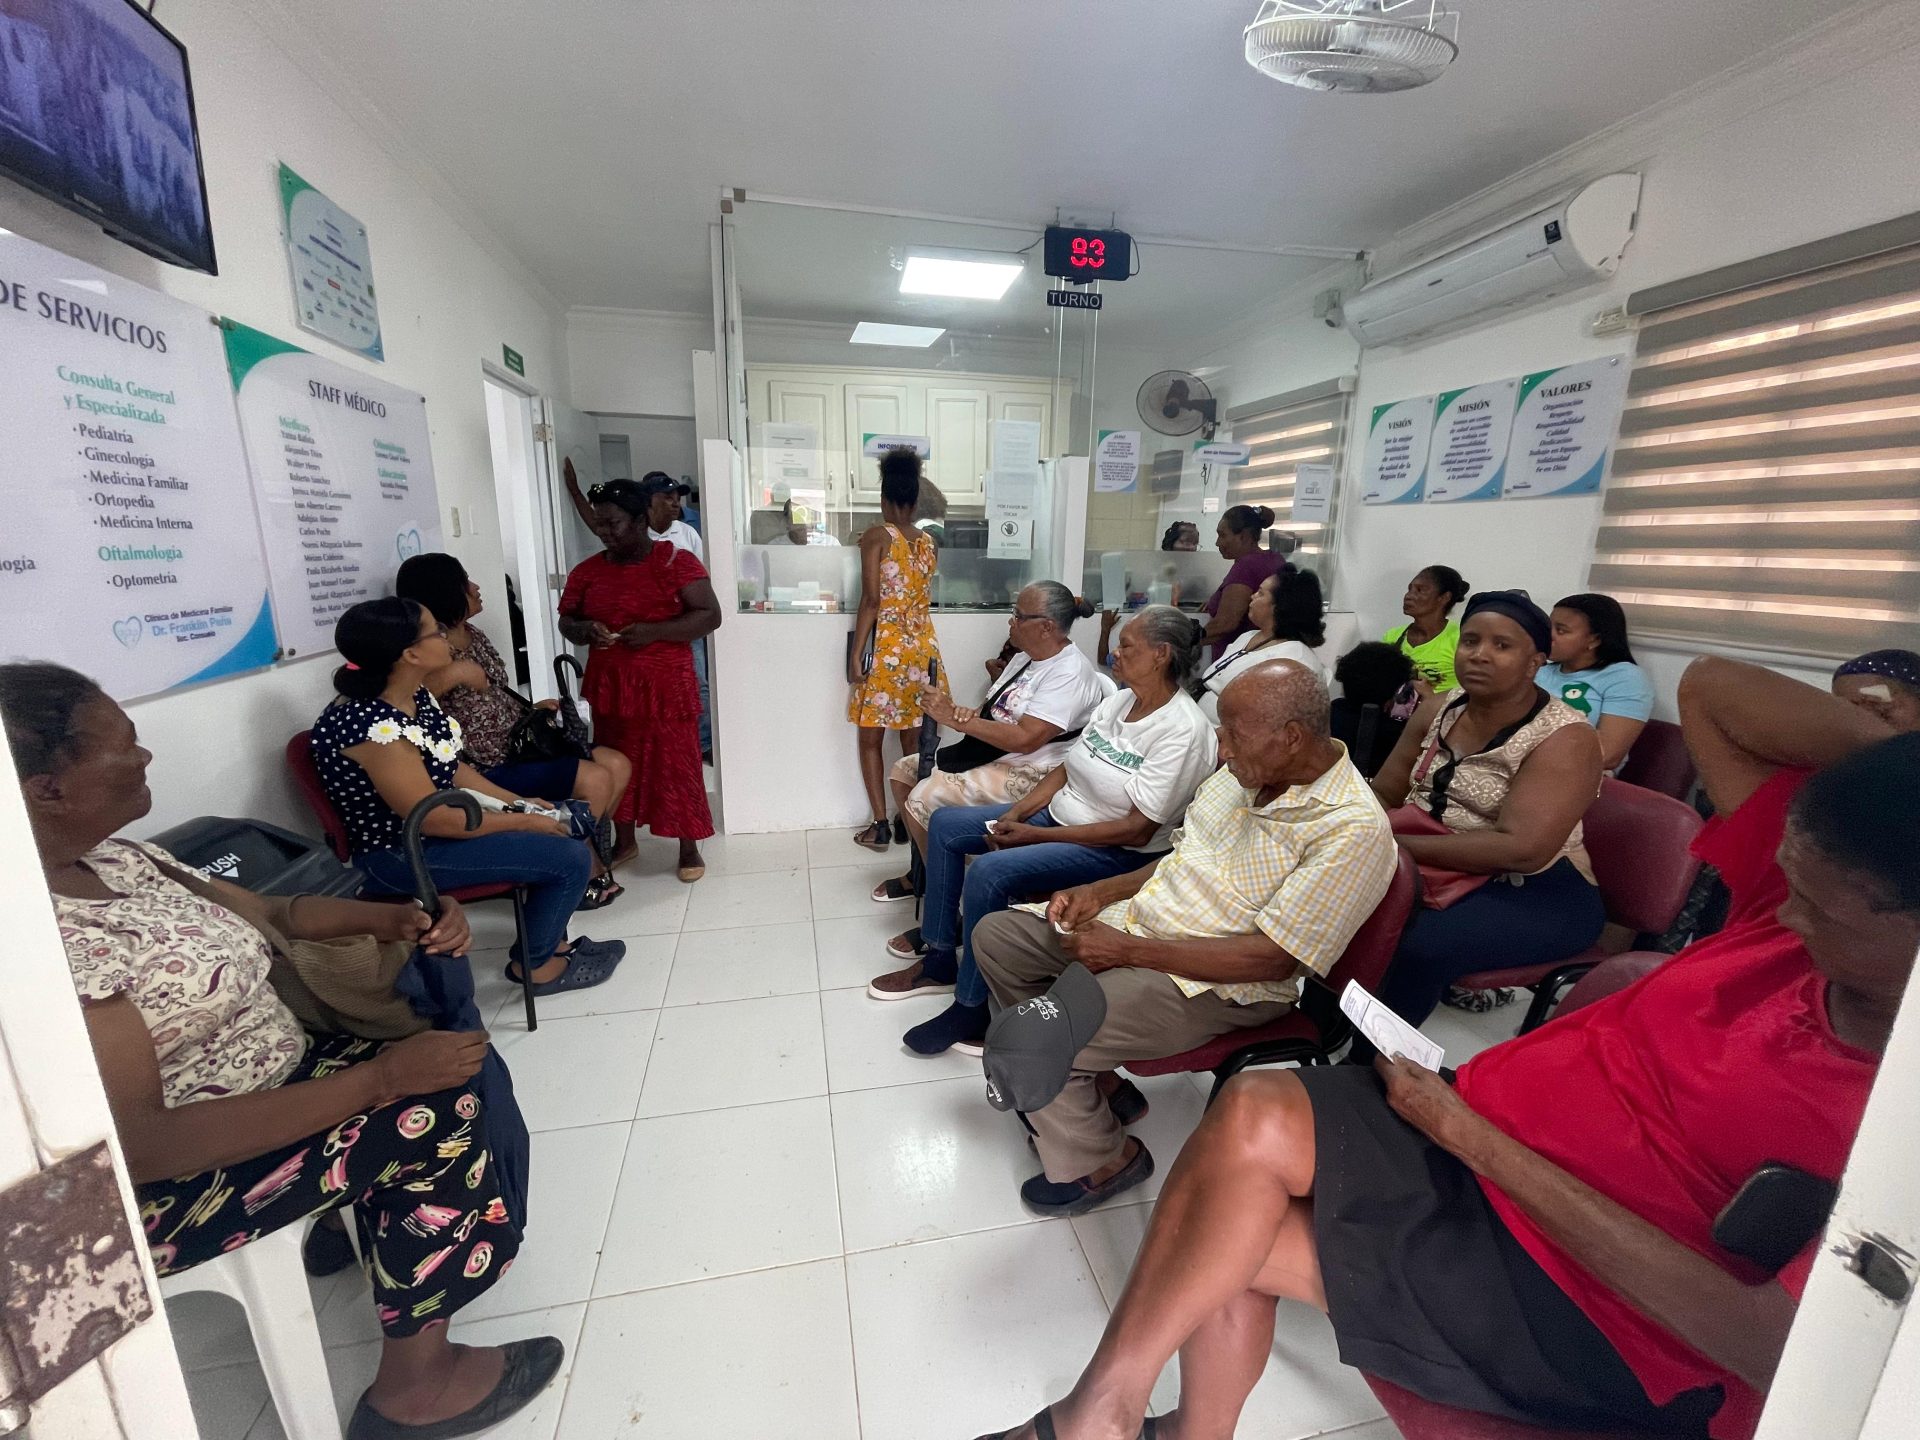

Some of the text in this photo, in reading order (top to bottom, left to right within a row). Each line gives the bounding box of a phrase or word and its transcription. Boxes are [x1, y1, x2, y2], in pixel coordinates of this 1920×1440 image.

[1071, 237, 1105, 268] 93
[1049, 291, 1100, 308] TURNO
[37, 291, 167, 353] SERVICIOS
[57, 365, 176, 405] Consulta General
[1540, 380, 1592, 398] VALORES
[309, 380, 386, 418] STAFF MÉDICO
[1458, 400, 1490, 414] MISIÓN
[63, 393, 166, 425] y Especializada
[1388, 418, 1413, 430] VISIÓN
[1535, 416, 1585, 430] Responsabilidad
[1546, 428, 1570, 437] Calidad
[1552, 464, 1567, 472] Dios
[90, 470, 189, 491] Medicina Familiar
[94, 492, 155, 510] Ortopedia
[100, 514, 194, 530] Medicina Interna
[170, 612, 179, 620] de
[180, 608, 209, 618] Medicina
[152, 625, 167, 636] Dr.
[169, 620, 209, 633] Franklin
[200, 852, 242, 876] PUSH
